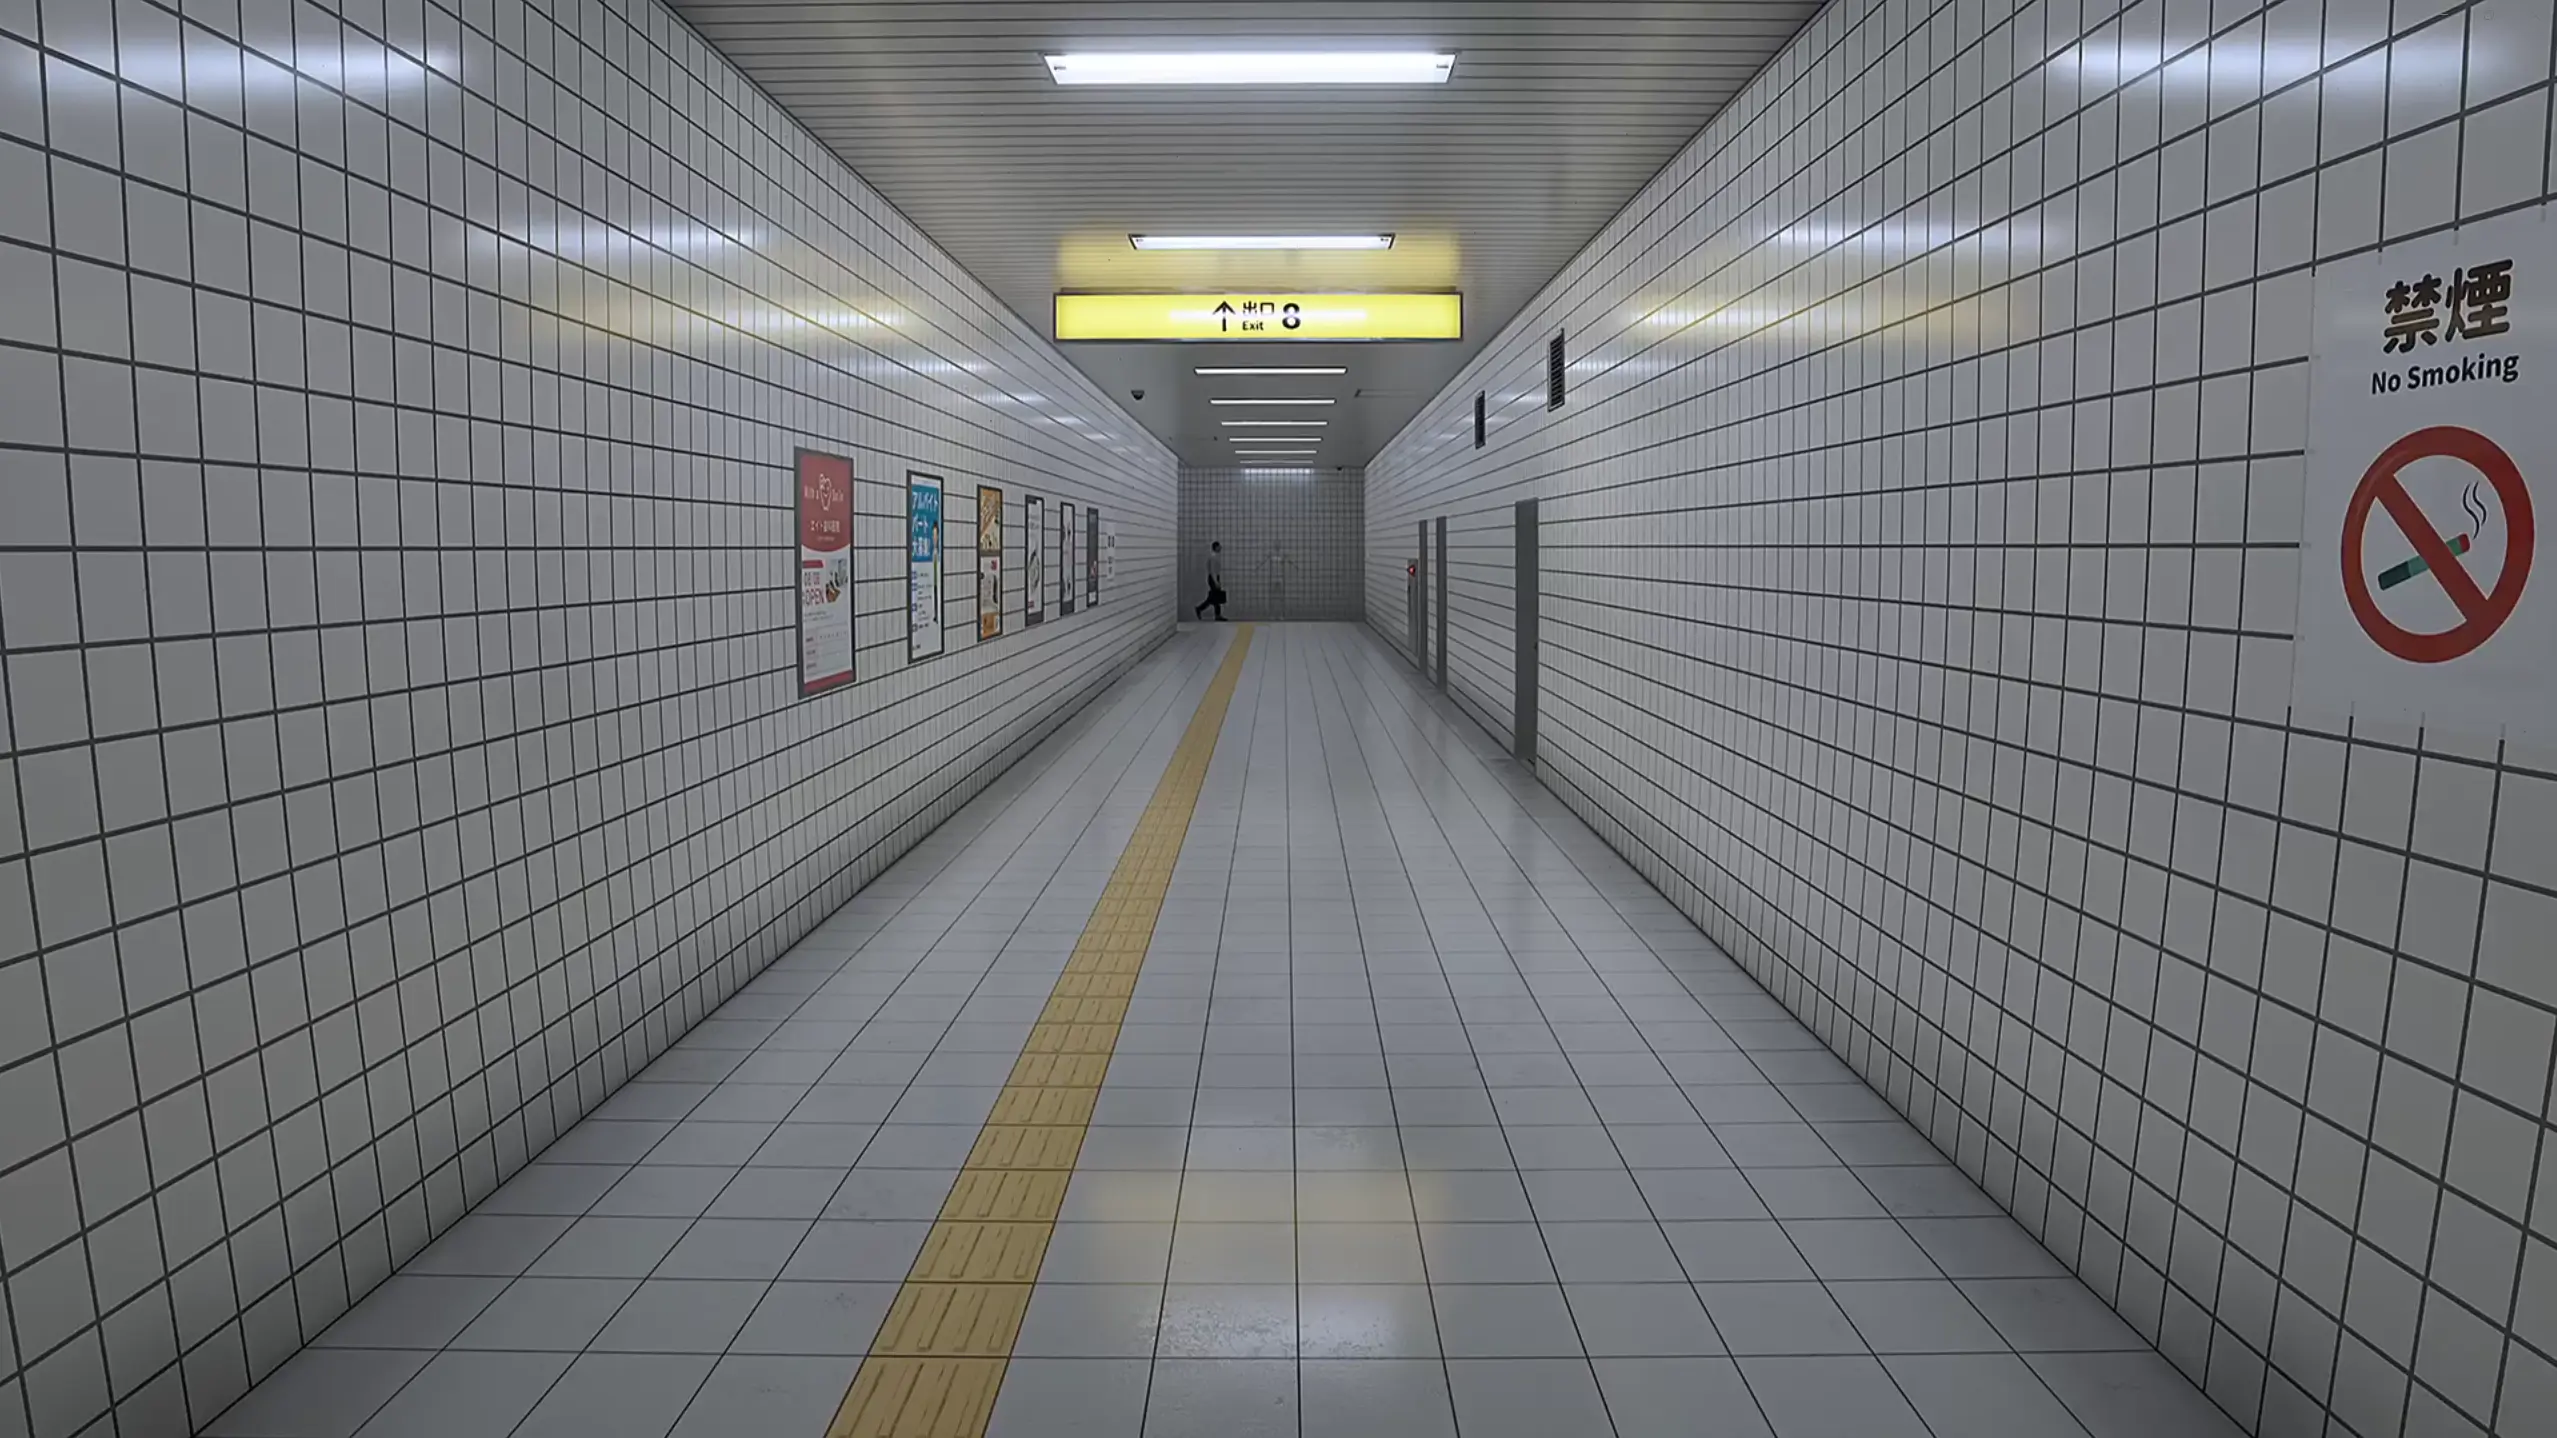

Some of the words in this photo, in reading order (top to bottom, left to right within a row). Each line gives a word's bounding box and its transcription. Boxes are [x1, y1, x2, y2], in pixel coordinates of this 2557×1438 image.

[1242, 301, 1275, 315] 出口
[1282, 302, 1301, 330] 8
[2382, 258, 2514, 355] 禁煙
[1242, 321, 1264, 331] Exit
[2371, 370, 2401, 395] No
[2407, 353, 2520, 390] Smoking
